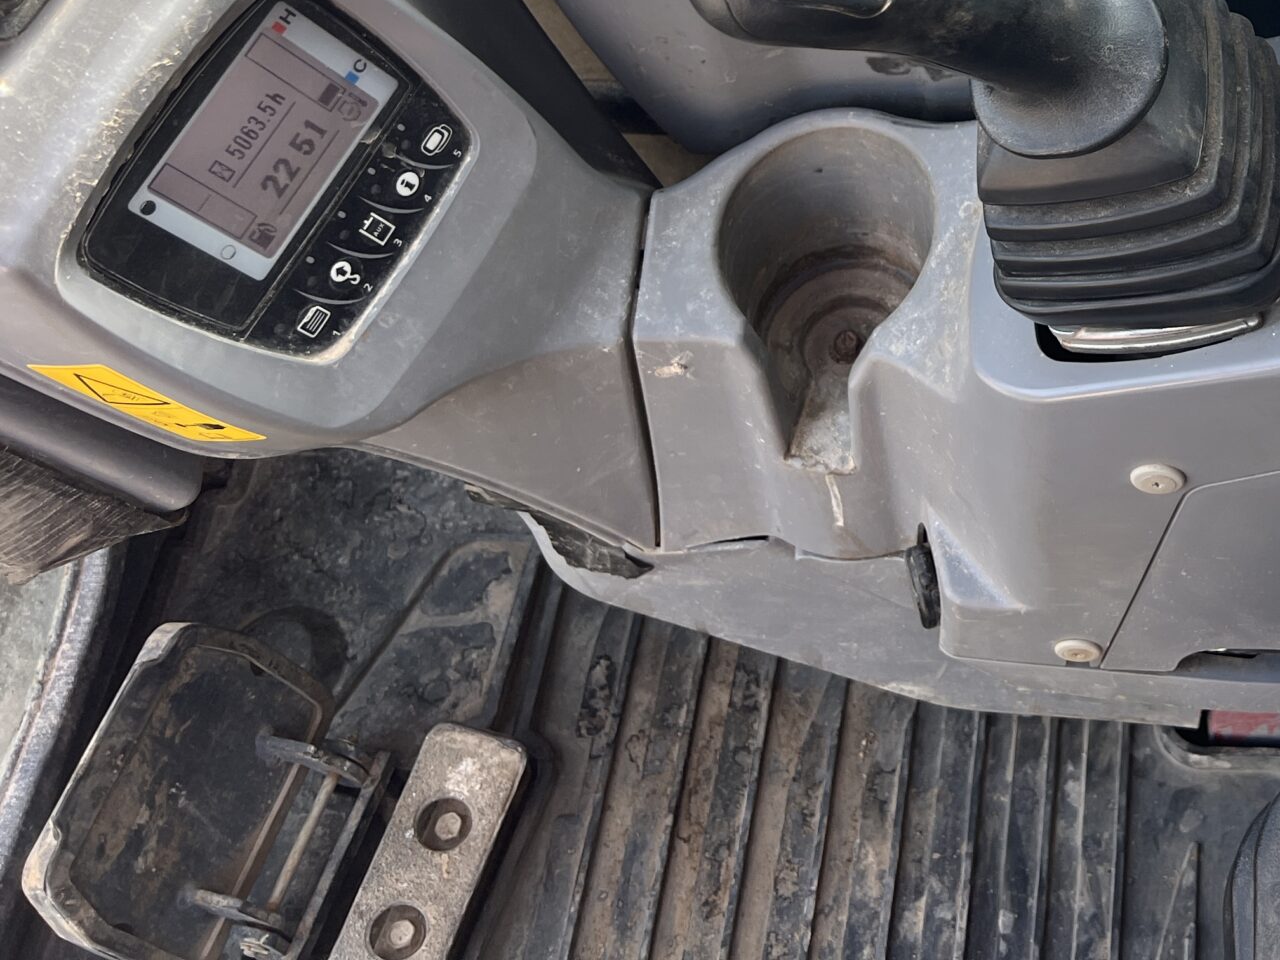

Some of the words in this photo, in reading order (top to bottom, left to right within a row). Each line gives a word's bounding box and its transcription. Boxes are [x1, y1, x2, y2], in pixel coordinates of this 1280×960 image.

[278, 7, 298, 26] H
[352, 58, 367, 73] C
[453, 148, 462, 158] 5
[424, 194, 432, 202] 4
[373, 222, 385, 238] AUX
[393, 238, 402, 247] 3
[363, 283, 373, 292] 2
